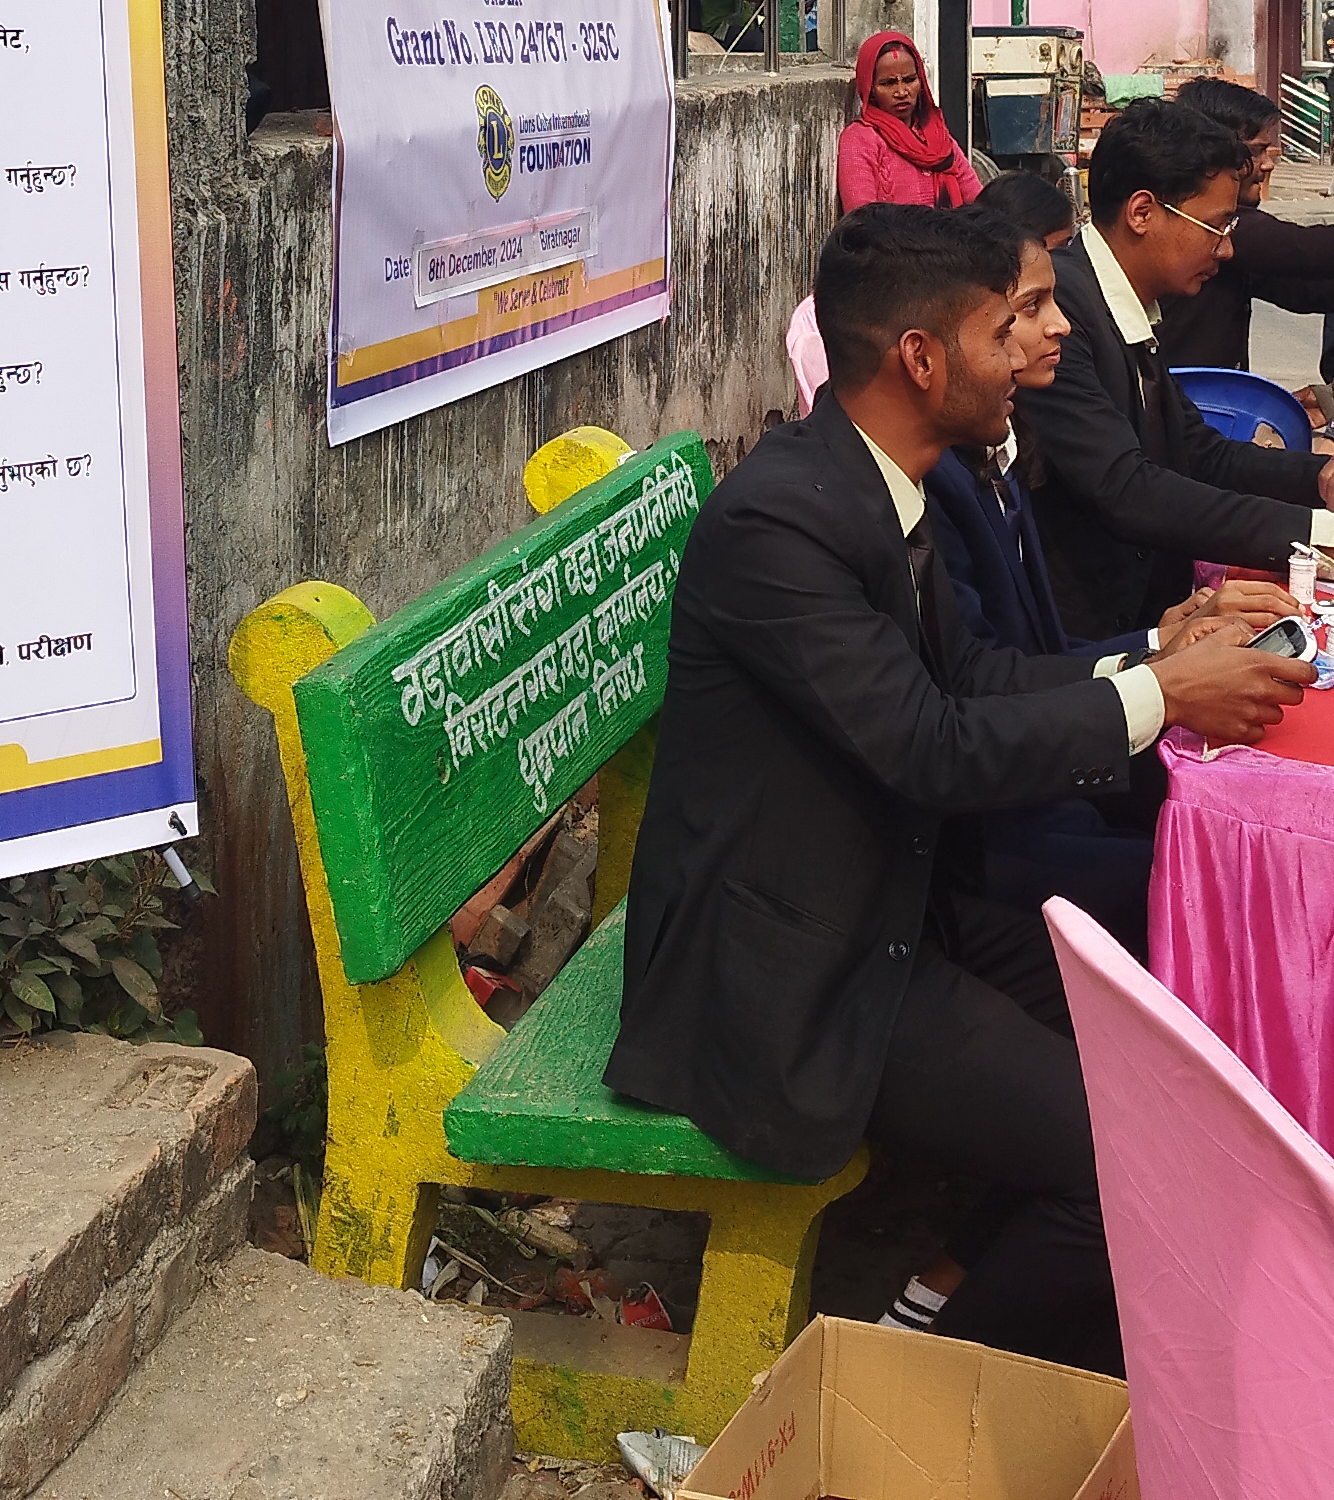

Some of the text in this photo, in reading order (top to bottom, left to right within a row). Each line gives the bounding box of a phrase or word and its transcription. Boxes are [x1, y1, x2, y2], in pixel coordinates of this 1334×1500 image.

[386, 16, 443, 66] Grant
[446, 18, 474, 66] No.
[476, 20, 513, 65] LEO
[514, 20, 566, 65] 24767
[581, 21, 620, 63] 325C
[491, 120, 503, 160] L
[519, 137, 591, 174] FOUNDATION
[428, 226, 581, 282] 8th December, 2024 Biratnagar
[17, 633, 93, 661] परीक्षण
